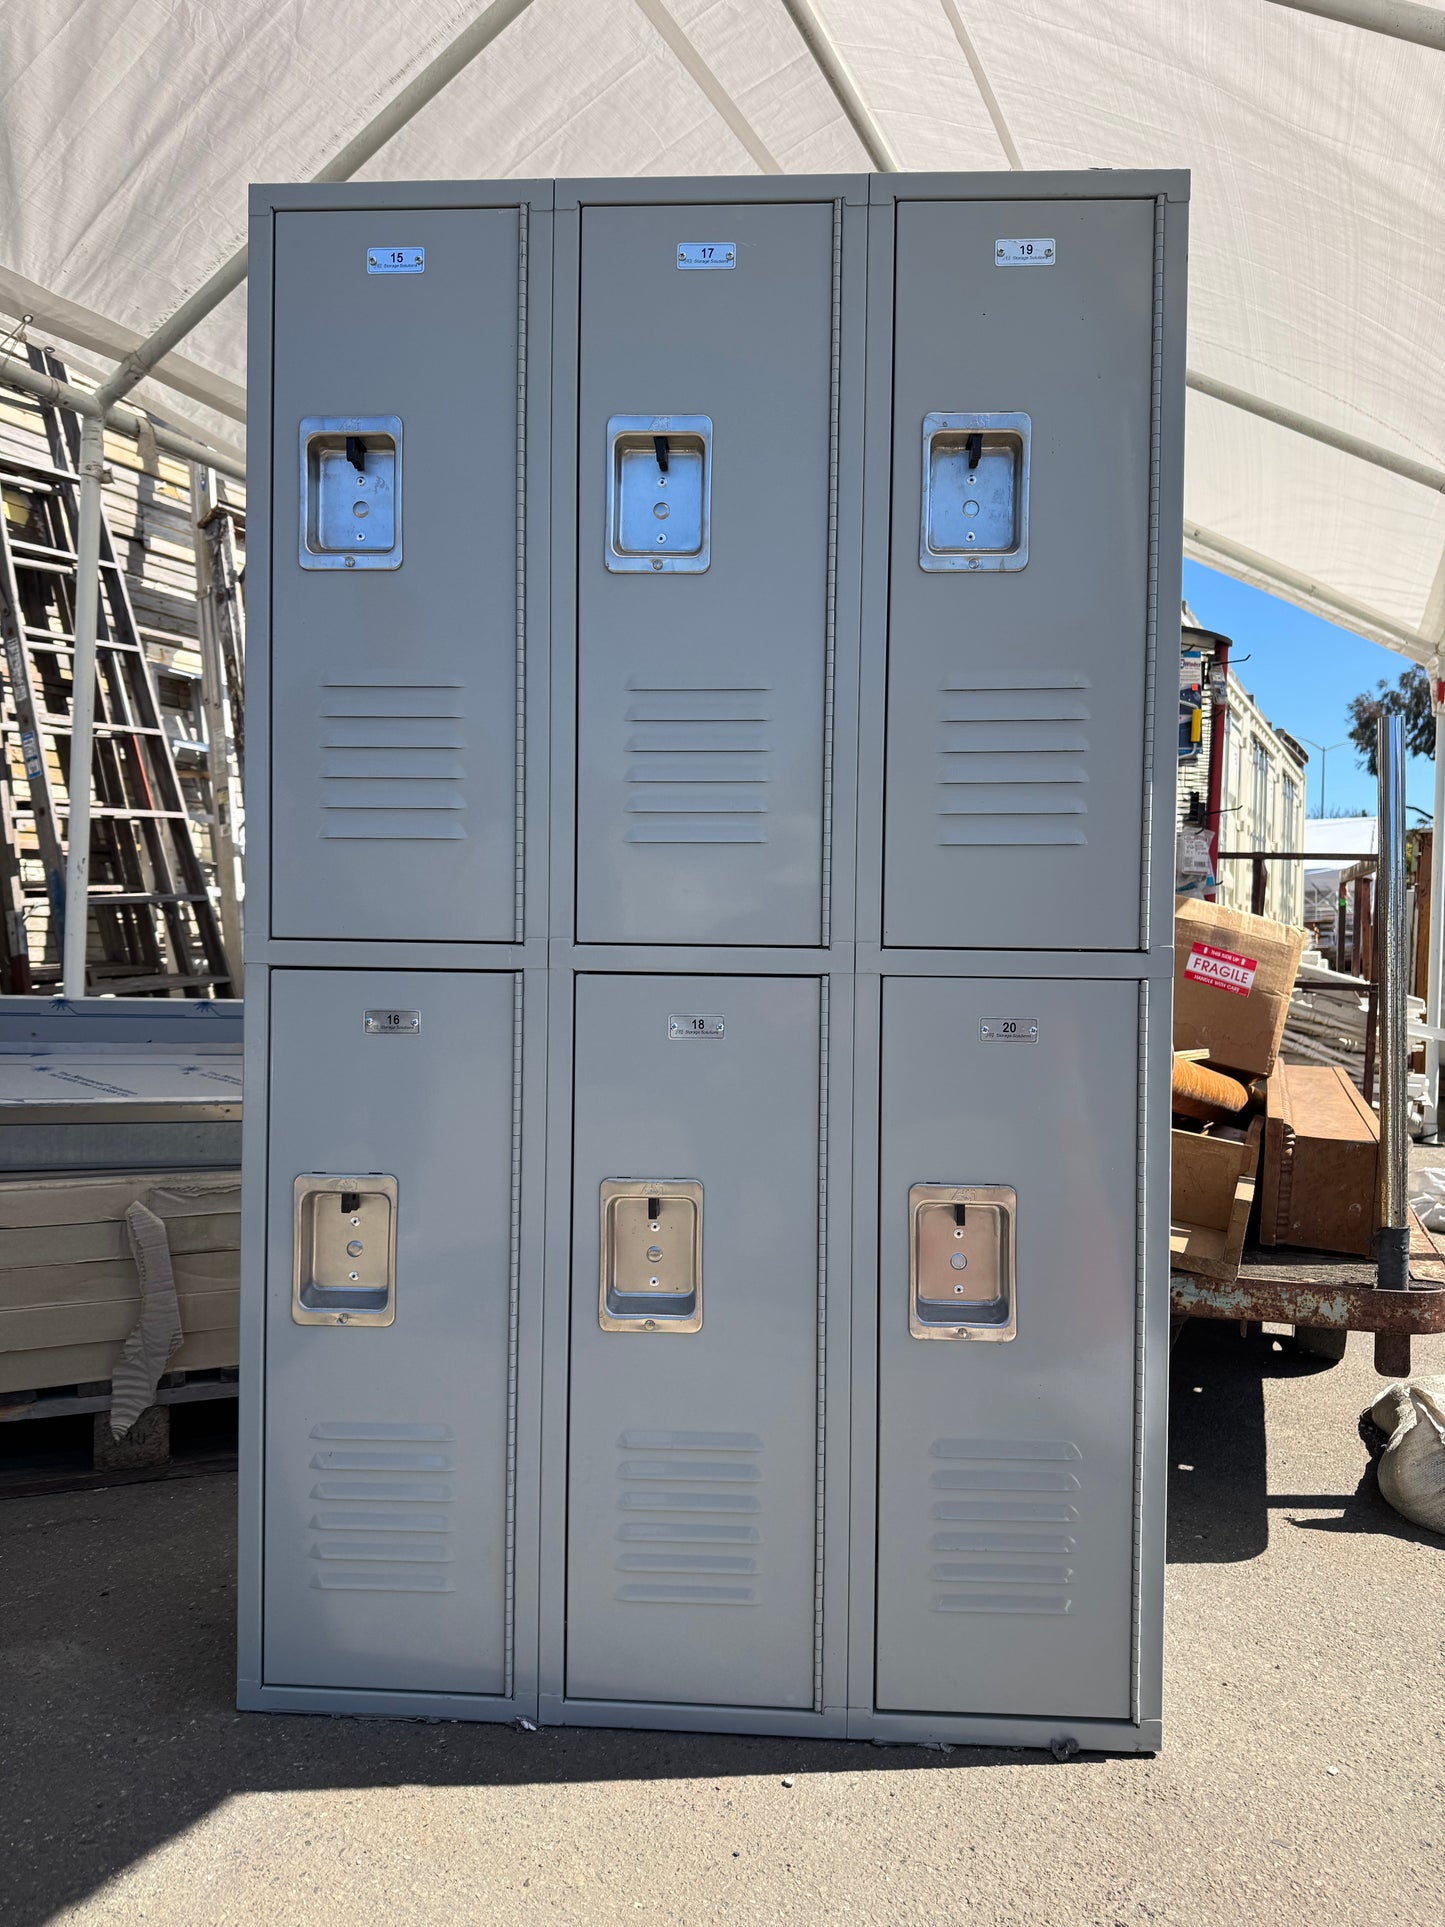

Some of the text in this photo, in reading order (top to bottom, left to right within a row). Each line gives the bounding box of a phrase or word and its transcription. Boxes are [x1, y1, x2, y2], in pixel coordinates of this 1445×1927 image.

[701, 248, 714, 258] 17
[1020, 244, 1033, 255] 19
[391, 252, 404, 263] 15
[1193, 957, 1249, 984] FRAGILE
[1194, 974, 1214, 985] HANDLE
[1226, 984, 1240, 993] CARE
[387, 1014, 400, 1025] 16
[692, 1019, 705, 1029] 18
[1002, 1022, 1017, 1033] 20
